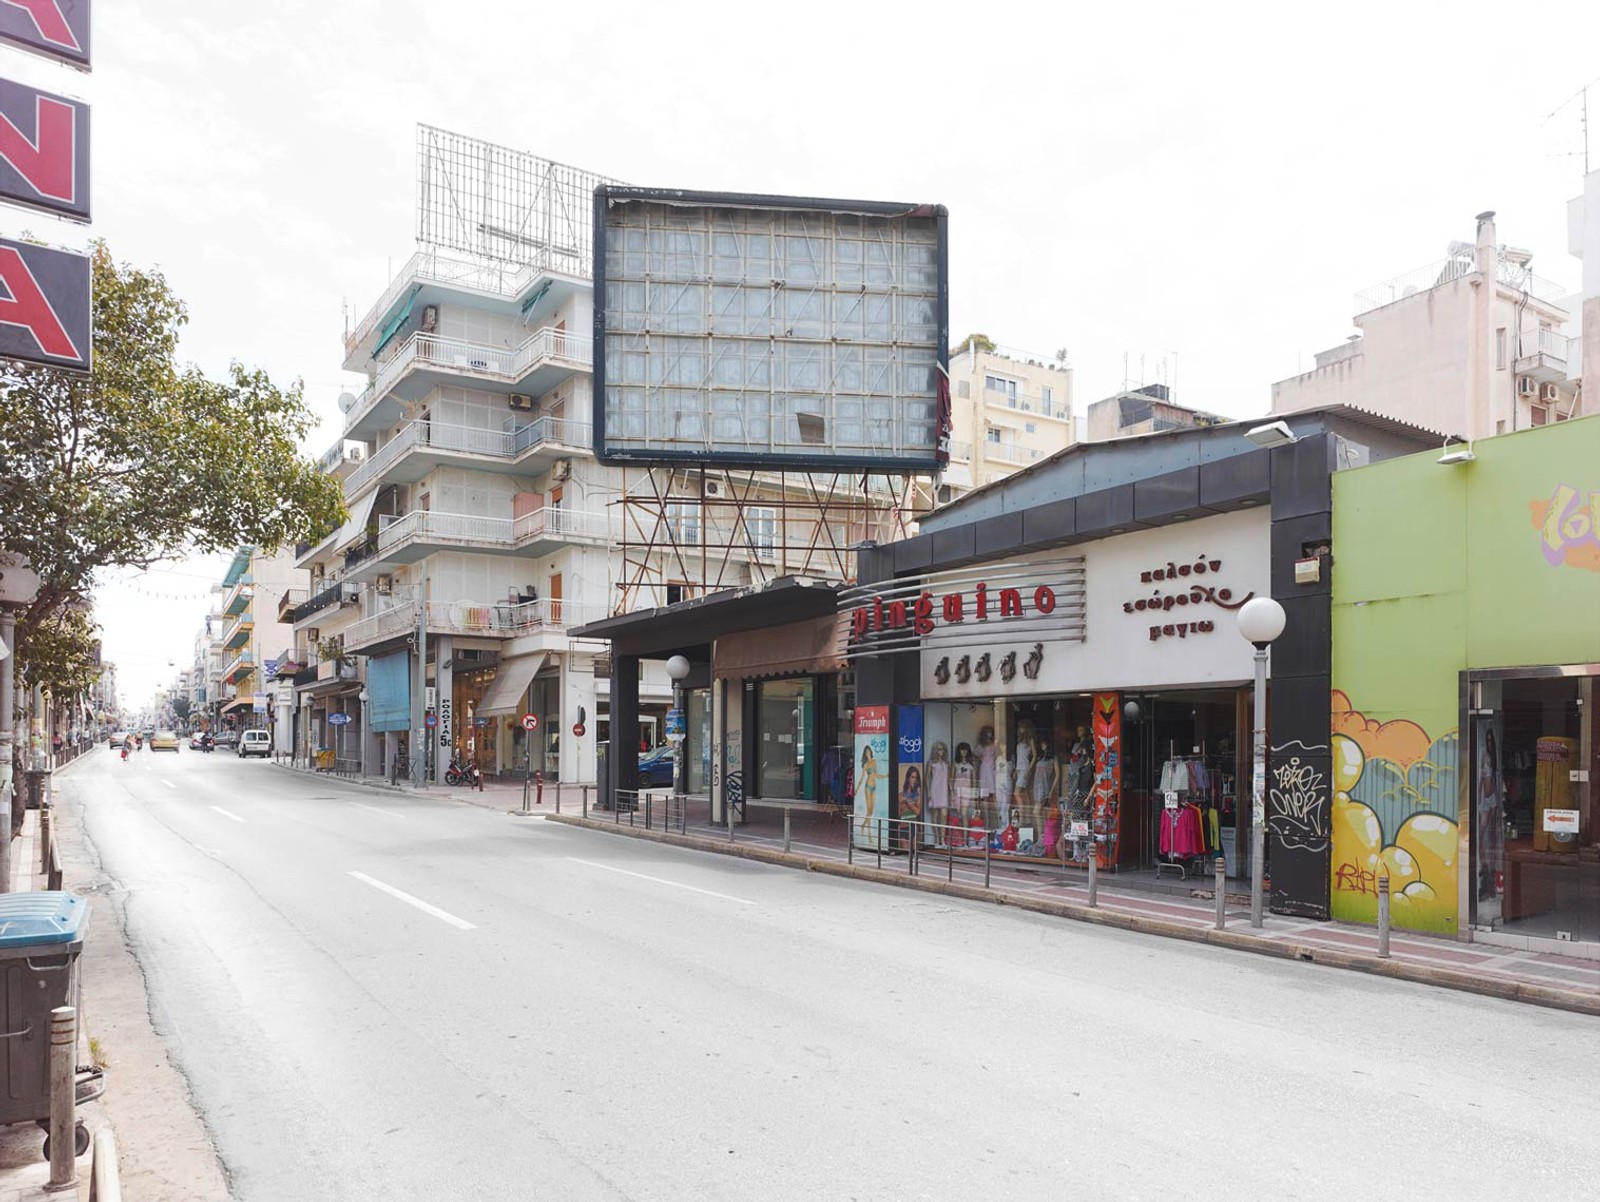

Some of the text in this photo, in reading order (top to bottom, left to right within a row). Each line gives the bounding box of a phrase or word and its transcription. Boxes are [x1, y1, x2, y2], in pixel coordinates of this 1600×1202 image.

[1141, 554, 1221, 583] καλσόν
[853, 581, 1056, 642] pinguino
[1123, 585, 1254, 613] εσώρουχο
[858, 715, 886, 730] Triumph
